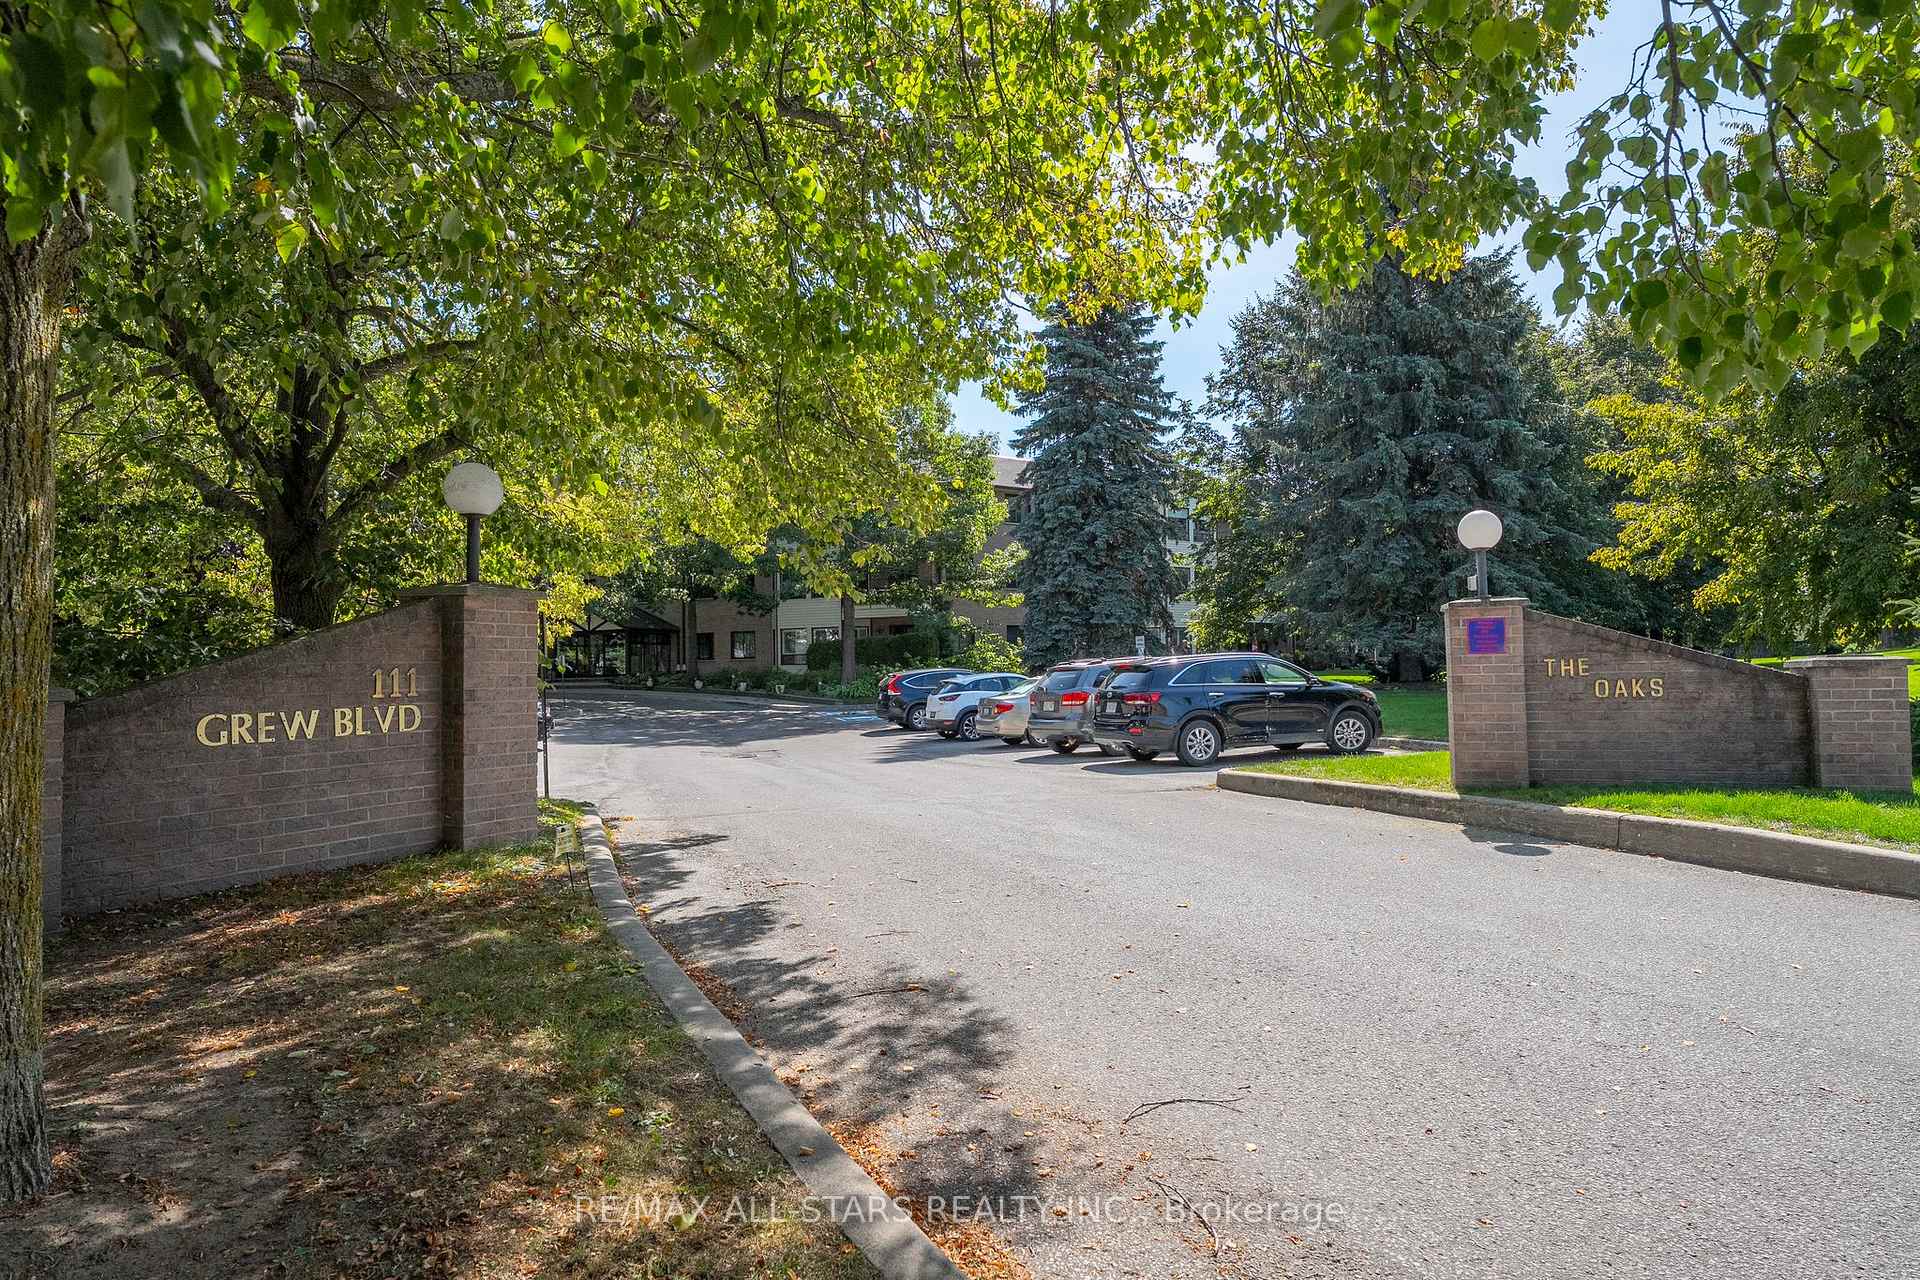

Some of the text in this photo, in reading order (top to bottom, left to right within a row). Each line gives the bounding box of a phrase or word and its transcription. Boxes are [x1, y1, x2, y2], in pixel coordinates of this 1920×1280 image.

[1543, 657, 1590, 677] THE
[370, 667, 419, 699] 111
[1594, 678, 1665, 698] OAKS
[196, 704, 423, 747] GREW BLVD
